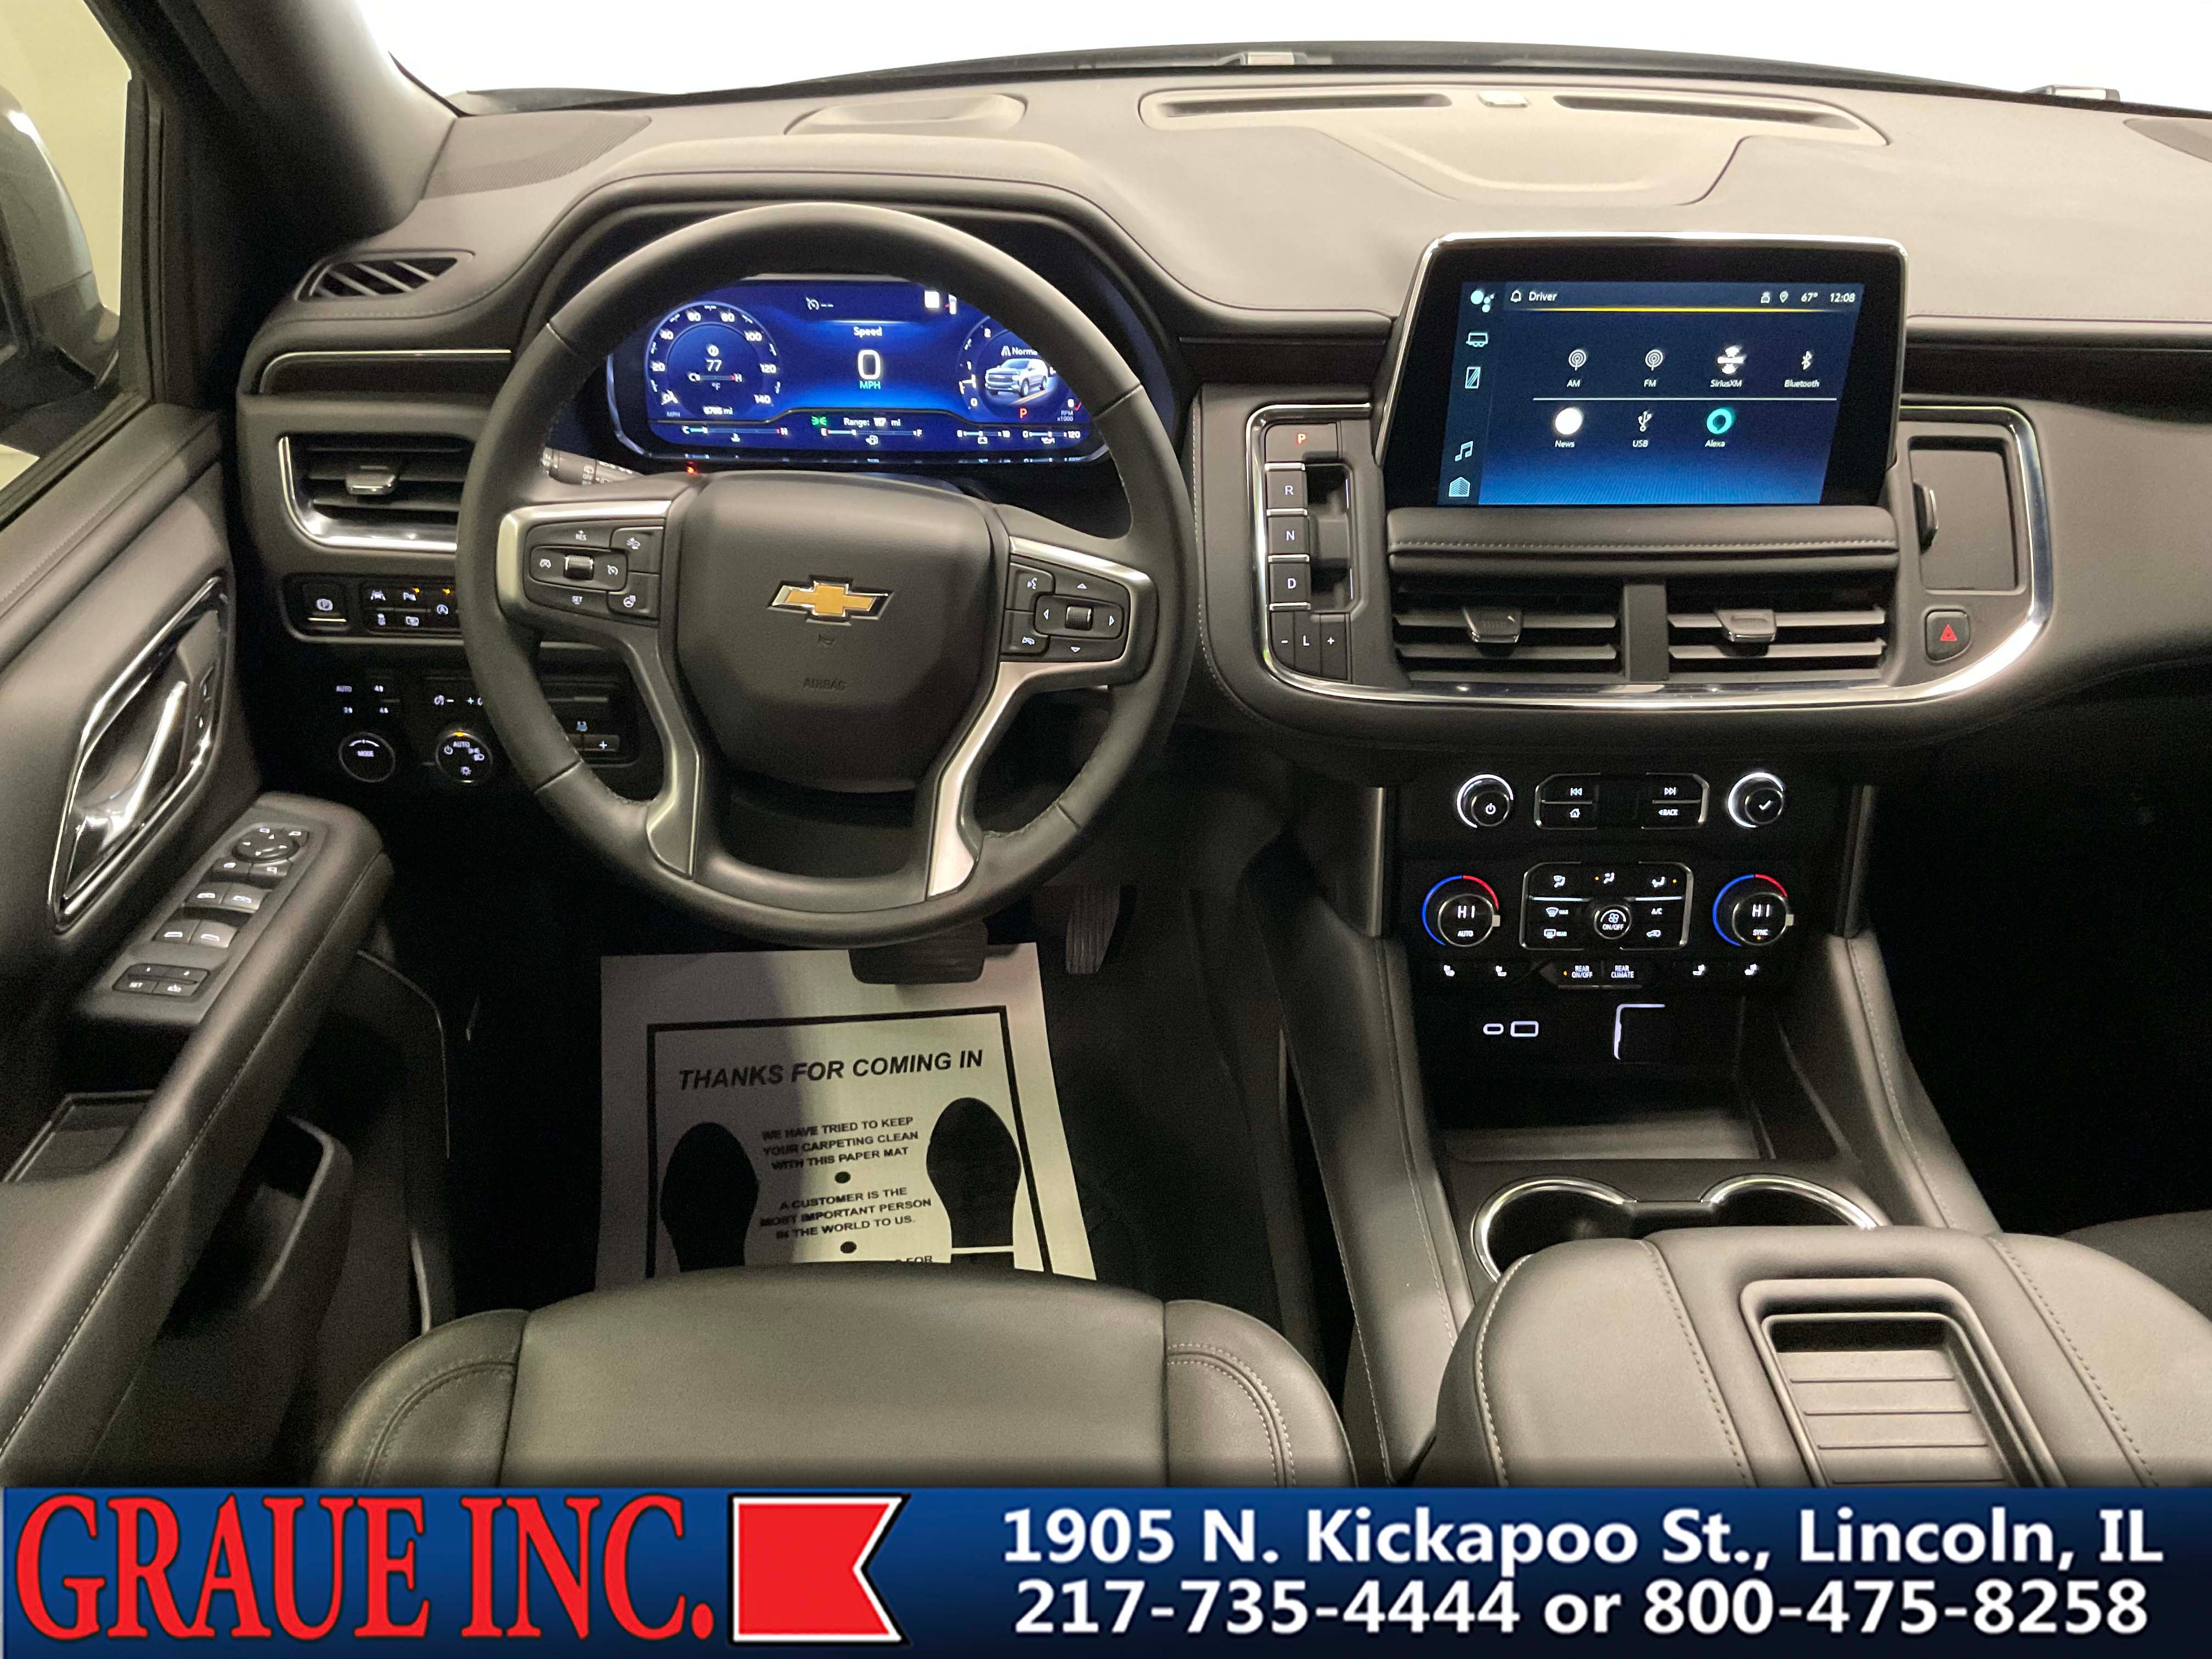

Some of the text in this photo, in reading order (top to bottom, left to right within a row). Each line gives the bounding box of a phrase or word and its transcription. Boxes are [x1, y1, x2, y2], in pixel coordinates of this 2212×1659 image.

[1528, 291, 1558, 302] Driver
[1801, 292, 1818, 302] 67°
[1830, 292, 1856, 302] 12:08
[745, 331, 762, 341] 100
[853, 326, 883, 338] Speed
[1012, 346, 1038, 356] Norma
[651, 362, 665, 372] 20
[706, 359, 722, 371] 77
[760, 363, 776, 373] 120
[857, 349, 881, 380] 0
[859, 380, 881, 390] MPH
[1710, 380, 1742, 388] SiriusXM
[1784, 380, 1820, 388] Bluetooth
[754, 394, 771, 404] 140
[724, 406, 733, 415] mi
[1019, 408, 1028, 418] P
[843, 417, 870, 428] Range:
[1297, 433, 1306, 444] P
[1554, 439, 1575, 448] News
[1632, 439, 1649, 448] USB
[1705, 439, 1725, 448] Alexa
[1285, 486, 1294, 495] R
[1286, 531, 1295, 540] N
[1286, 578, 1296, 589] D
[1303, 635, 1310, 646] L
[679, 1048, 983, 1091] THANKS FOR COMING IN
[762, 1116, 913, 1141] WE HAVE TRIED TO KEEP
[763, 1131, 919, 1156] YOUR CARPETING CLEAN
[771, 1146, 909, 1170] WITH THIS PAPER MAT
[780, 1187, 907, 1210] A CUSTOMER IS THE
[800, 1205, 876, 1222] IMPORTANT
[879, 1198, 932, 1212] PERSON
[795, 1226, 819, 1238] THE
[821, 1220, 871, 1234] WORLD
[873, 1217, 891, 1227] TO
[895, 1215, 916, 1224] US.
